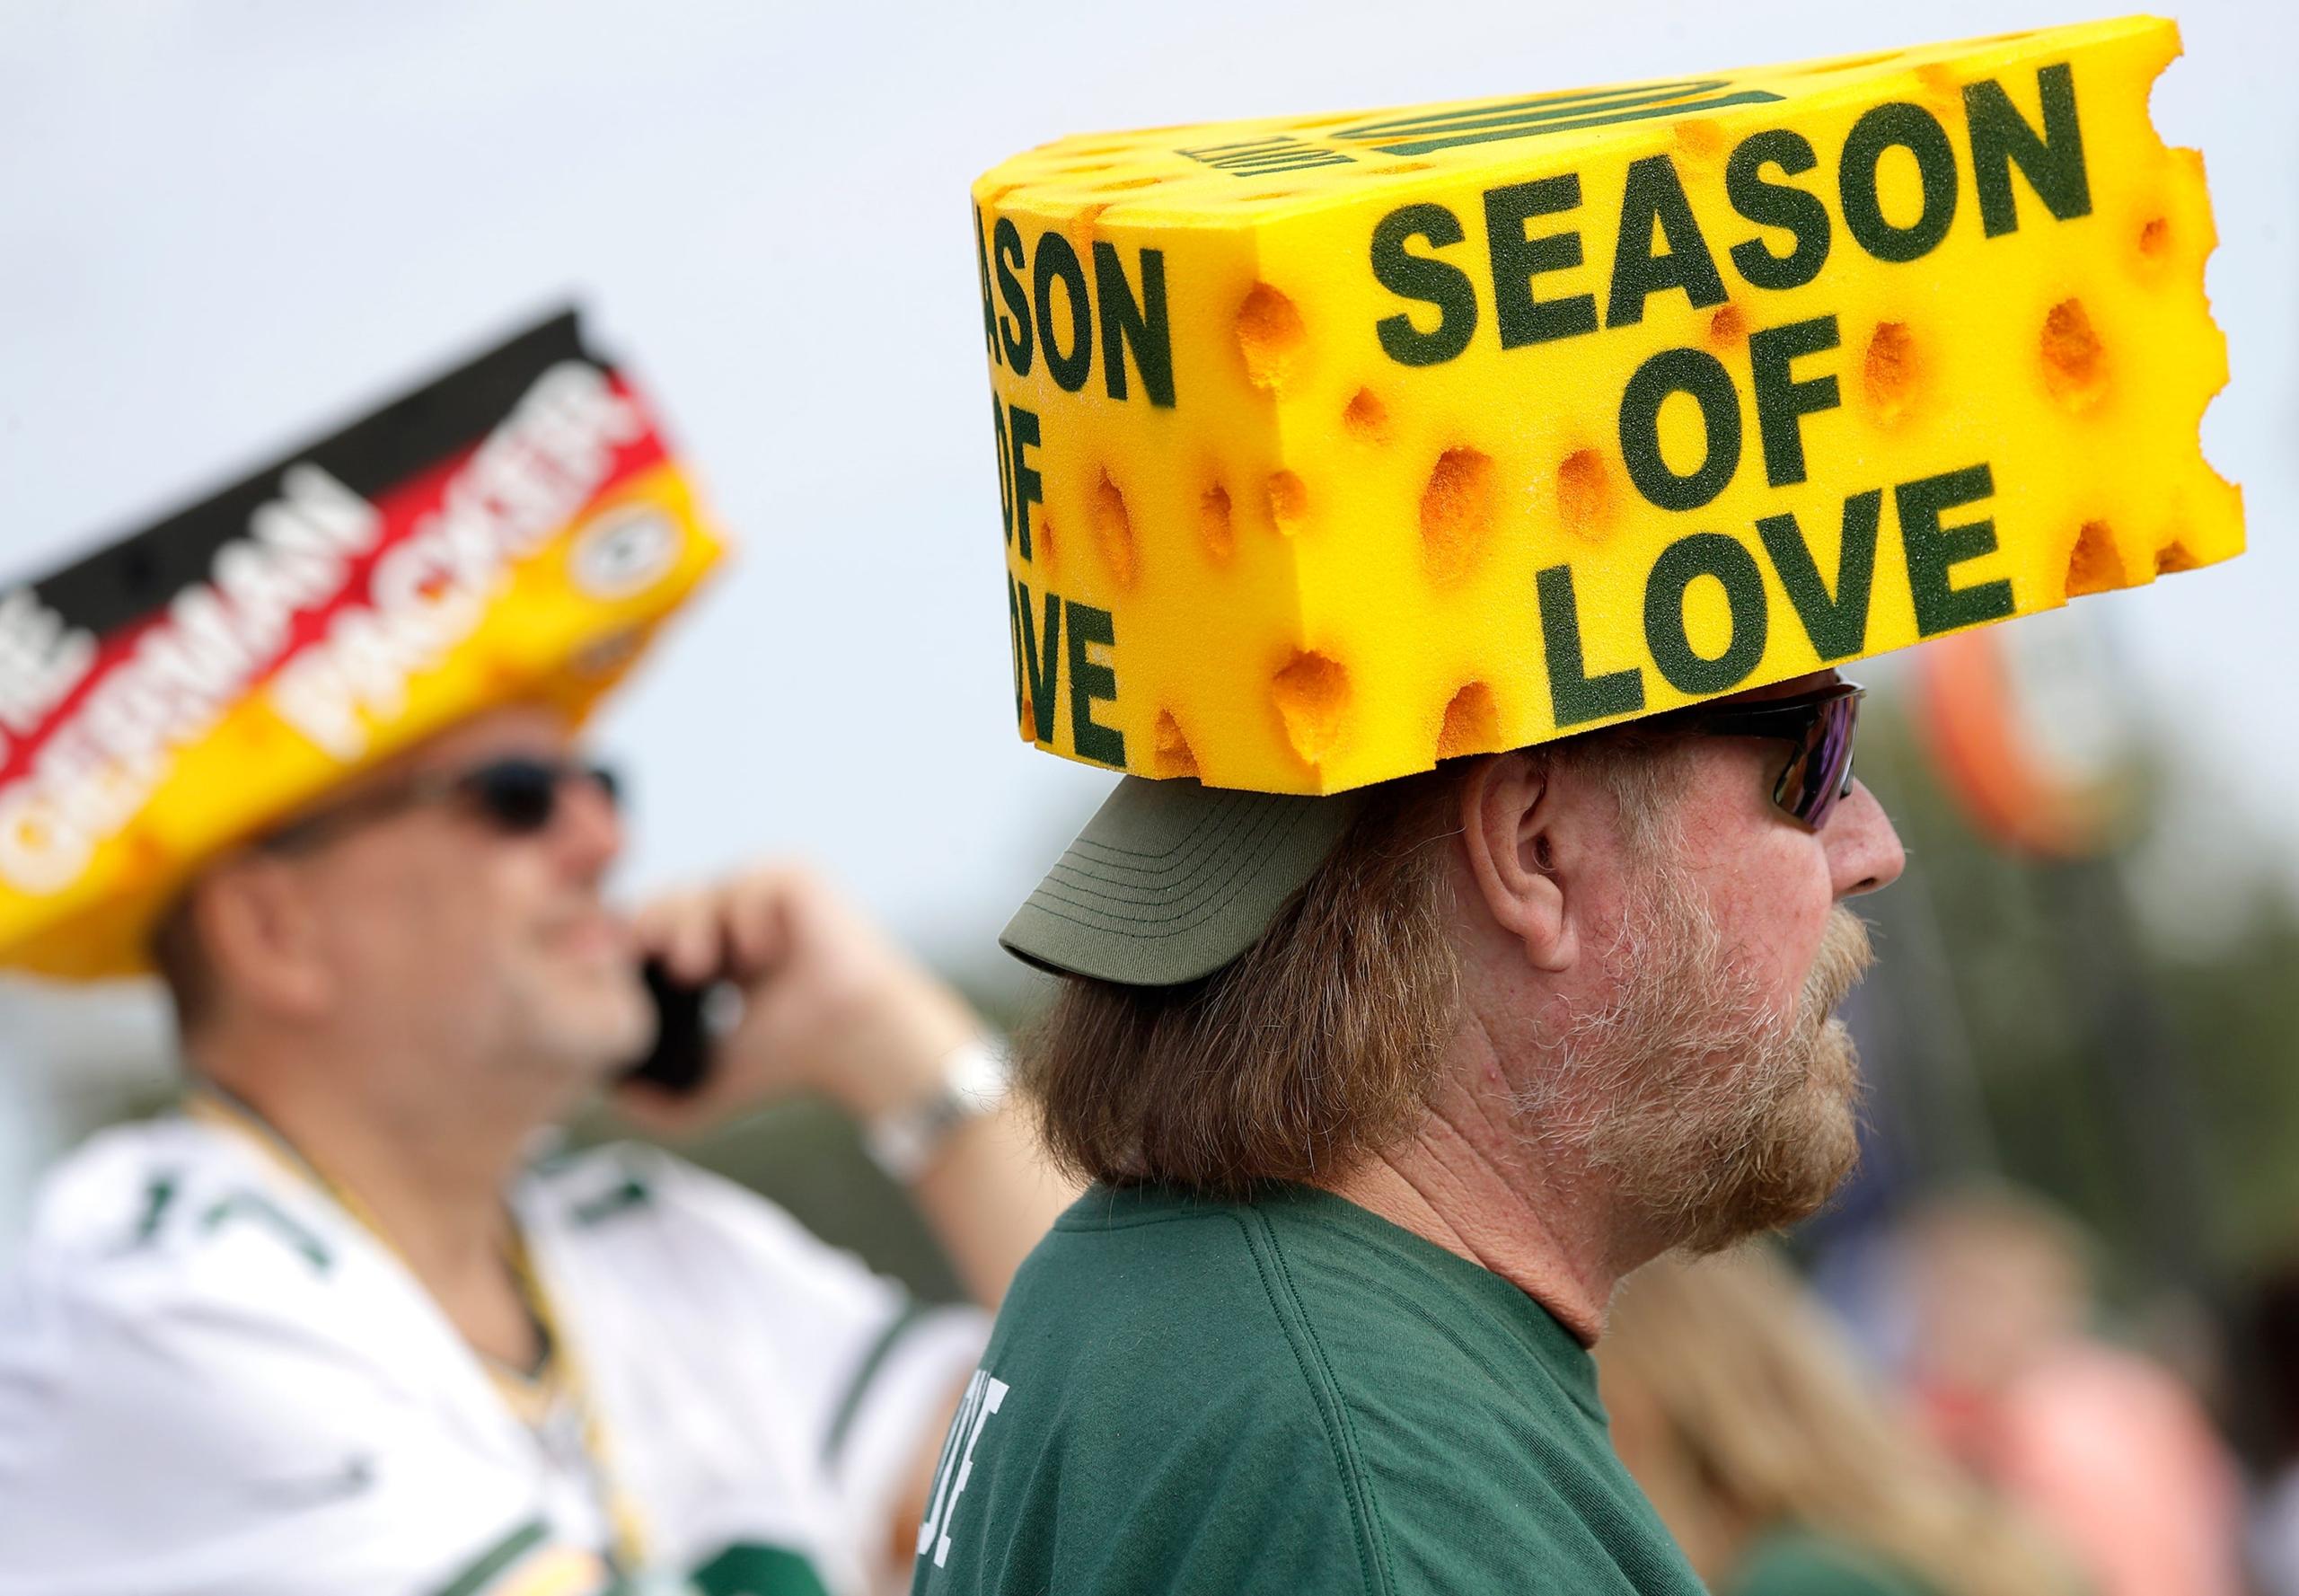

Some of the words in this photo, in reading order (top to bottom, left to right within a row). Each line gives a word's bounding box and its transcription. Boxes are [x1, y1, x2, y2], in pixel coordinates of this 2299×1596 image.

[1370, 63, 2093, 366] SEASON
[993, 390, 1044, 562] OF
[1619, 314, 1842, 514] OF
[0, 458, 386, 896] GERMAN
[271, 357, 648, 765] PACKER
[1536, 462, 2017, 728] LOVE
